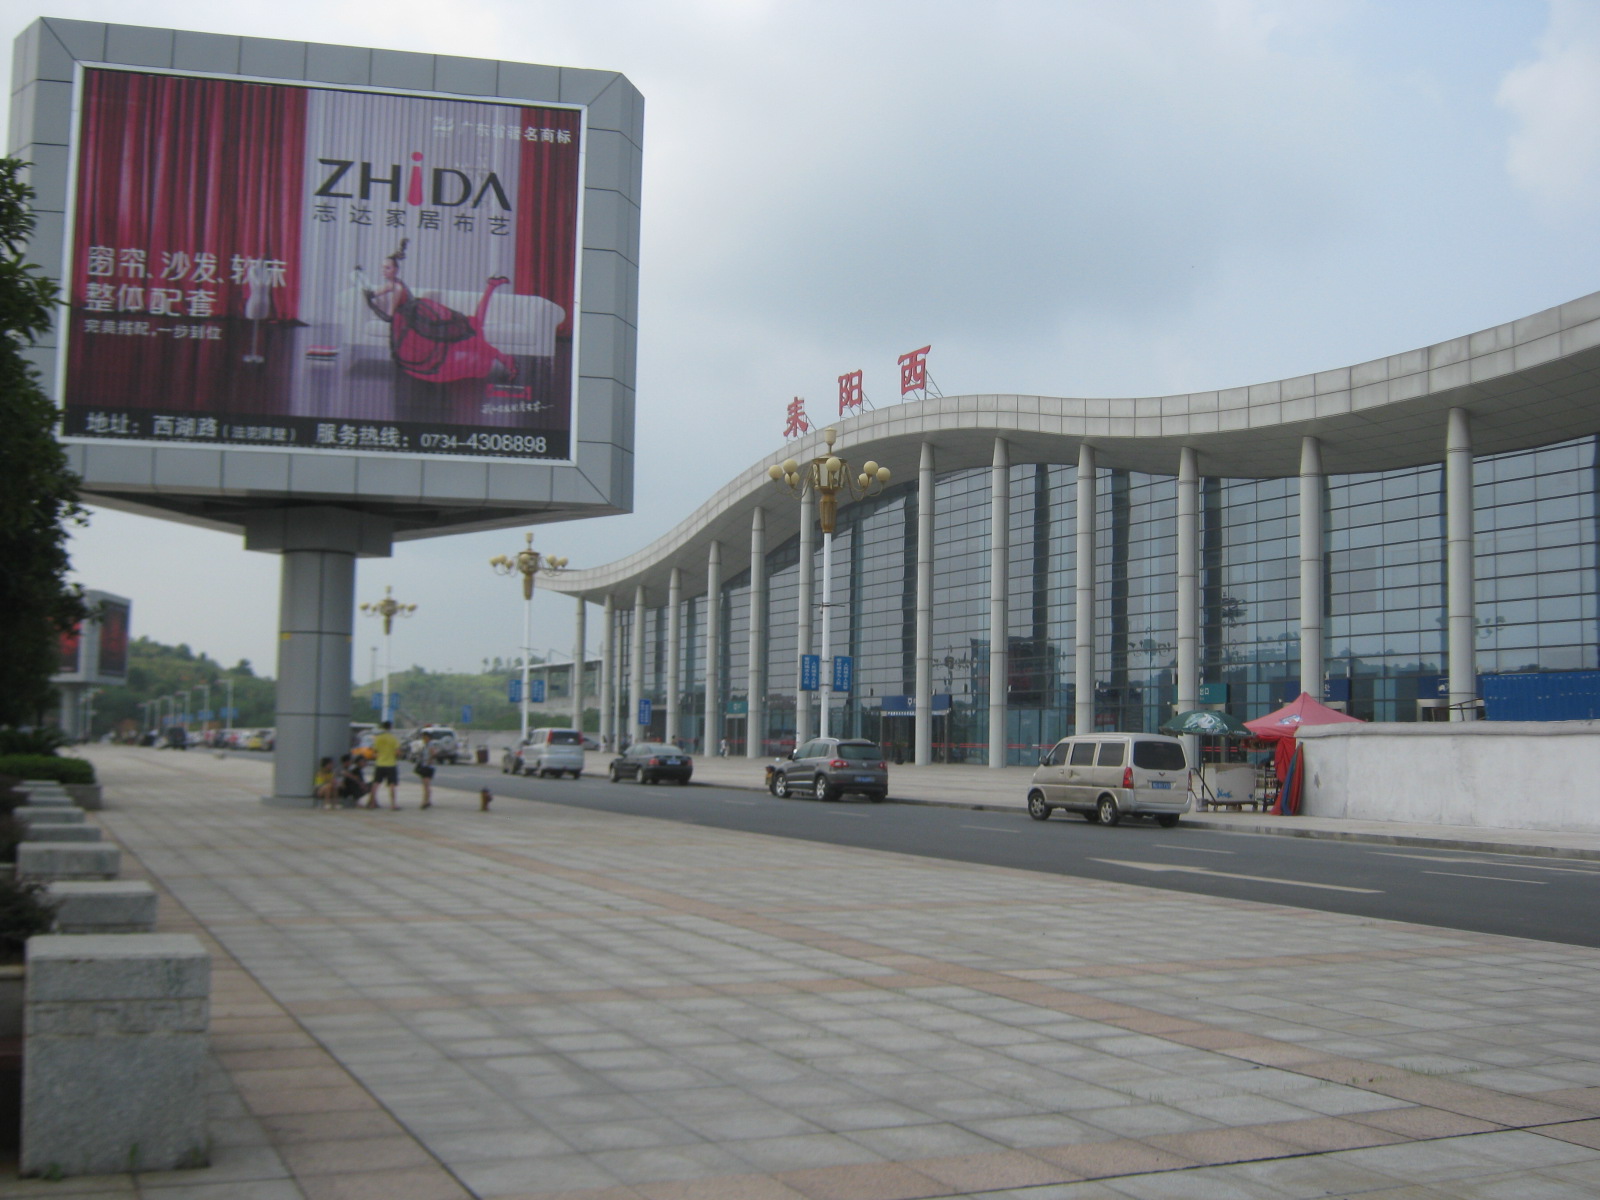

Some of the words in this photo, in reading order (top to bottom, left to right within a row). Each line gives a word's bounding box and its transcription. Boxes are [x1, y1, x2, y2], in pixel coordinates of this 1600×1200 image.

[313, 203, 510, 236] 志达家居布艺
[82, 282, 218, 318] 整体配套
